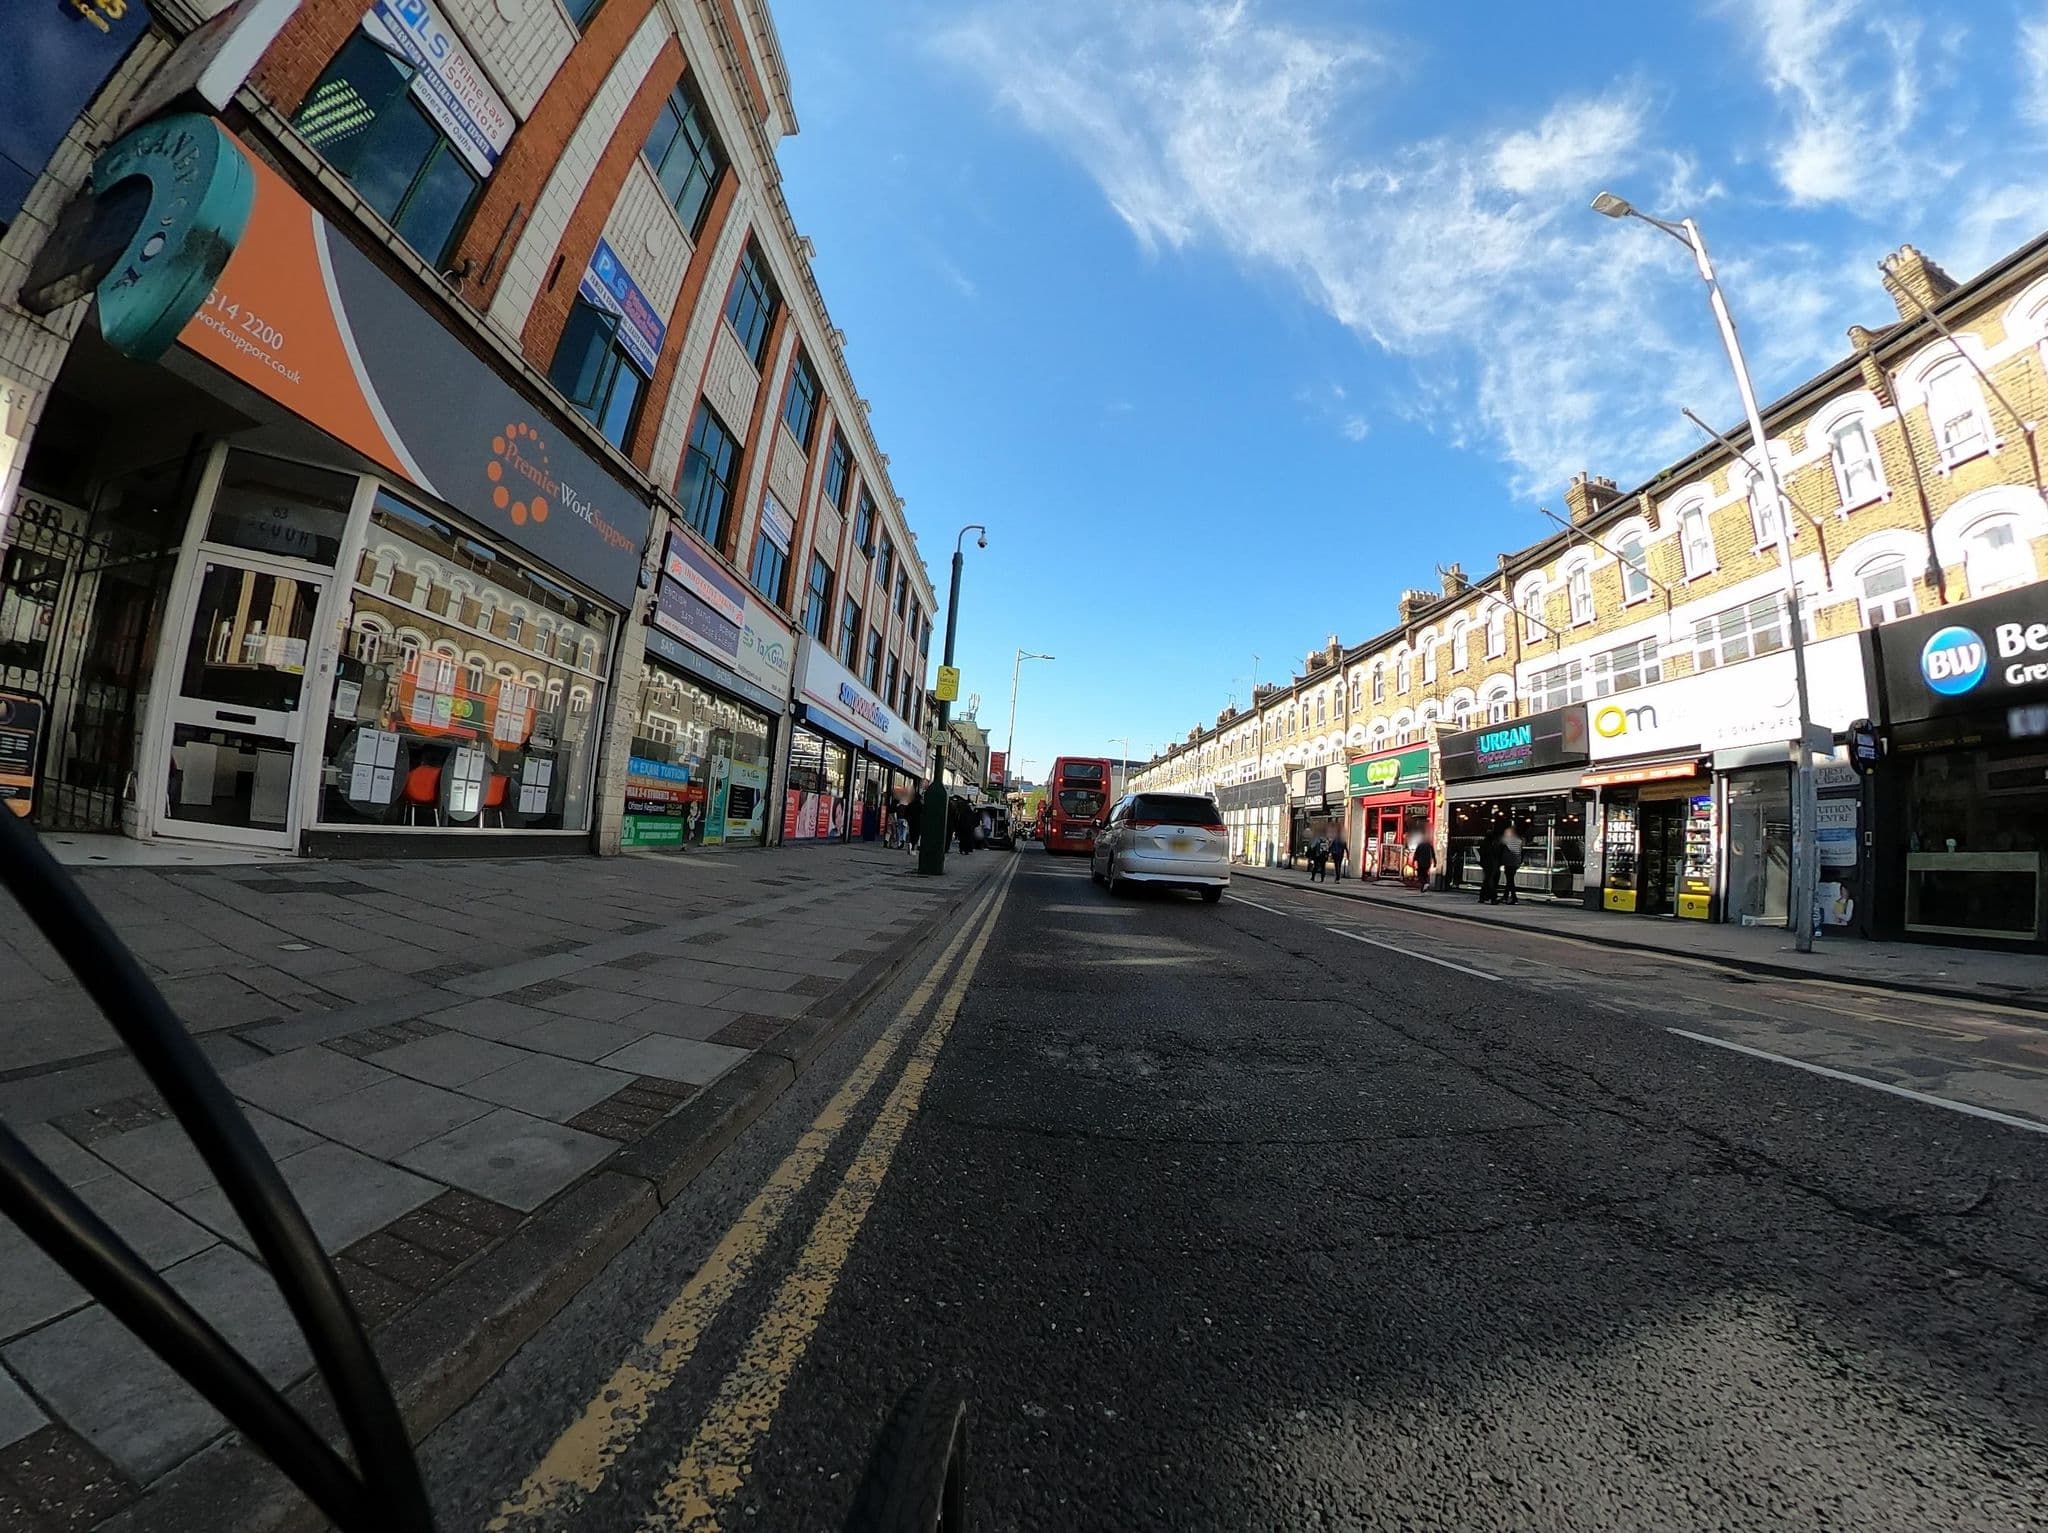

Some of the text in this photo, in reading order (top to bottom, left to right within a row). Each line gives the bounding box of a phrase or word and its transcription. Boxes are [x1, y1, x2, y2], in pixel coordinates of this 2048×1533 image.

[445, 66, 499, 141] Solicitors
[453, 55, 506, 129] Prime Law
[441, 112, 454, 128] for
[451, 125, 473, 152] Oaths
[240, 311, 284, 350] 2200
[505, 441, 561, 499] Premier
[1996, 623, 2048, 658] Be
[1928, 643, 1981, 680] BW
[2006, 663, 2048, 684] Gre
[1480, 724, 1531, 753] URBAN
[640, 761, 659, 777] EXAM
[661, 765, 687, 780] TUITION
